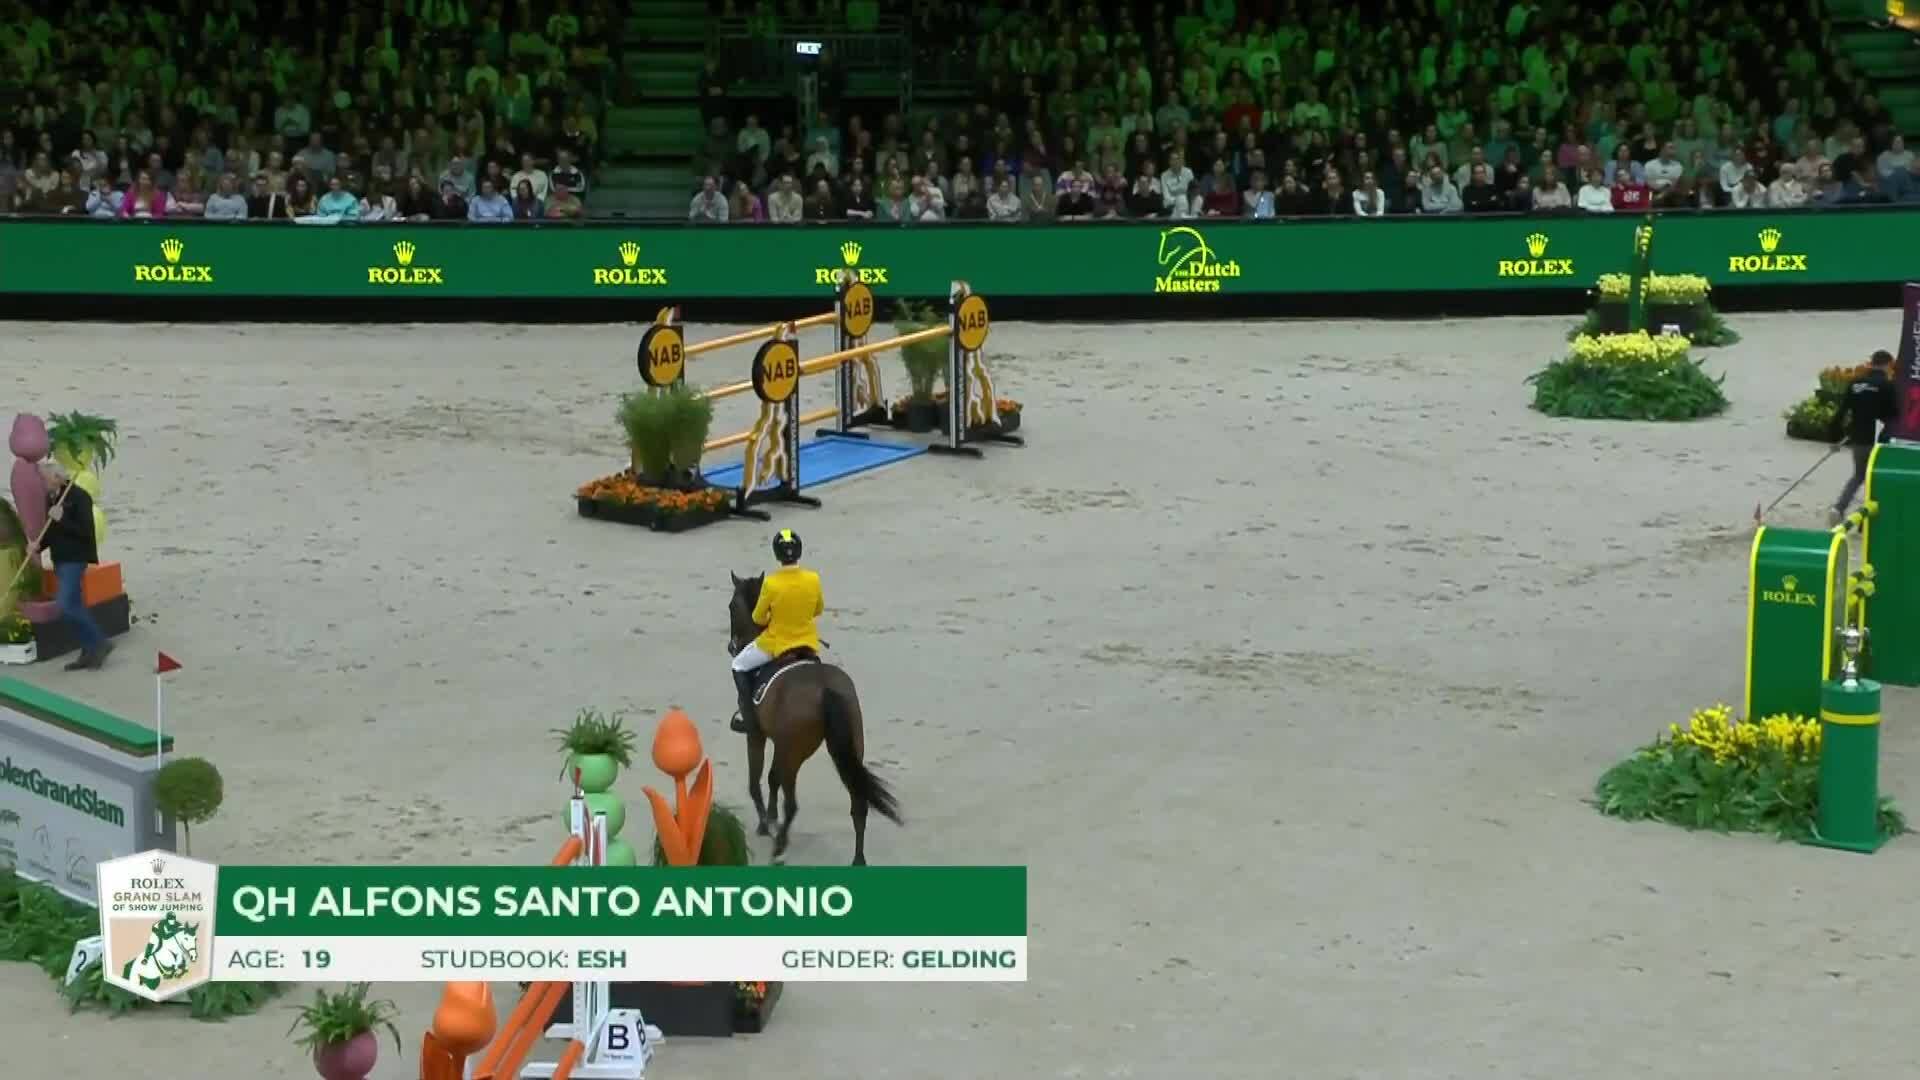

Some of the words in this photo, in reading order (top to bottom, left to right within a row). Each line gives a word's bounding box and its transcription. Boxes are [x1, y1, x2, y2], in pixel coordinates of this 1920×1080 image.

[1189, 260, 1241, 277] Dutch
[1499, 259, 1574, 276] ROLEX
[1729, 255, 1807, 272] ROLEX
[134, 265, 212, 283] ROLEX
[367, 267, 443, 284] ROLEX
[593, 268, 667, 285] ROLEX
[815, 268, 889, 285] ROEX
[1155, 276, 1219, 292] Masters
[650, 343, 682, 368] NAB
[763, 358, 796, 383] NAB
[1763, 591, 1816, 607] ROLEX
[75, 950, 87, 973] 2
[608, 1025, 628, 1049] B
